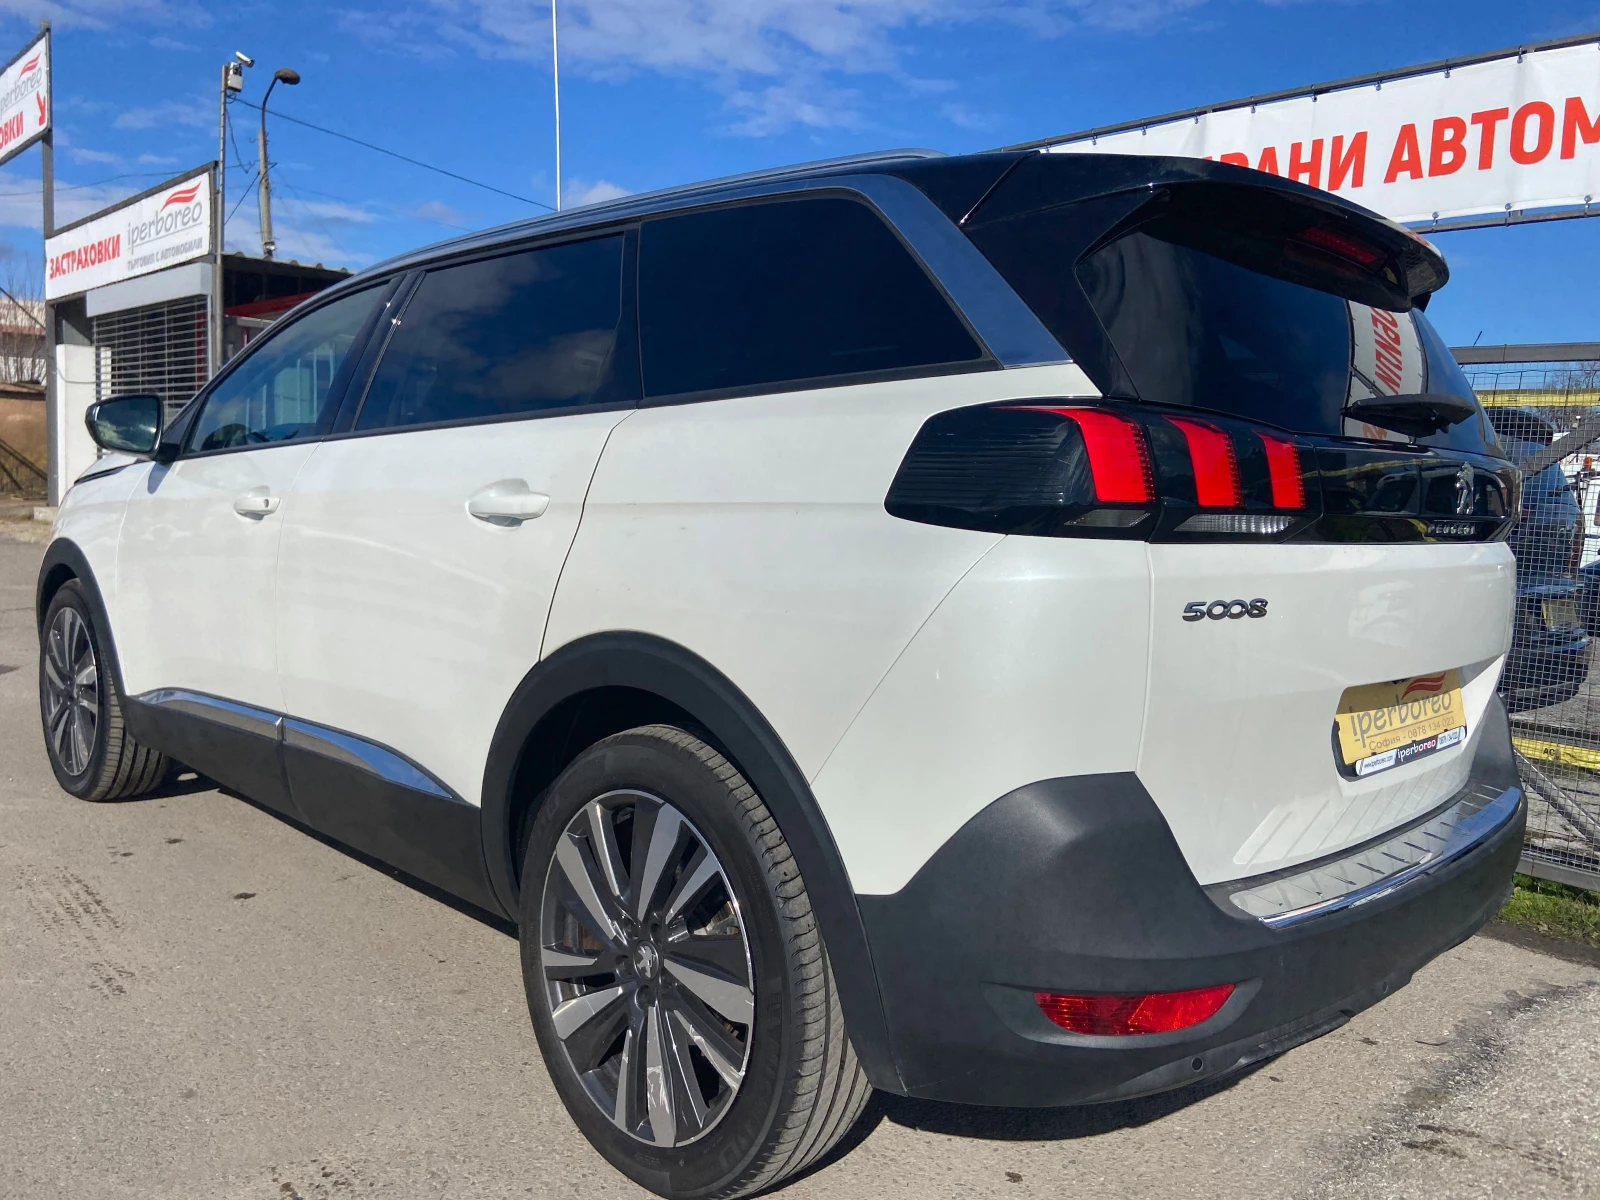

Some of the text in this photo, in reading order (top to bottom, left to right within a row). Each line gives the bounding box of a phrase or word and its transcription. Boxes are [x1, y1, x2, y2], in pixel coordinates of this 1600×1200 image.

[127, 202, 203, 255] iperboreo
[49, 234, 121, 279] ЗАСТРАХОВКИ
[1182, 598, 1268, 622] 5008
[1349, 691, 1453, 748] iperboreo
[1369, 735, 1401, 751] София
[1407, 725, 1427, 739] 0878
[1428, 720, 1440, 733] 134
[1397, 739, 1437, 761] iperboreo
